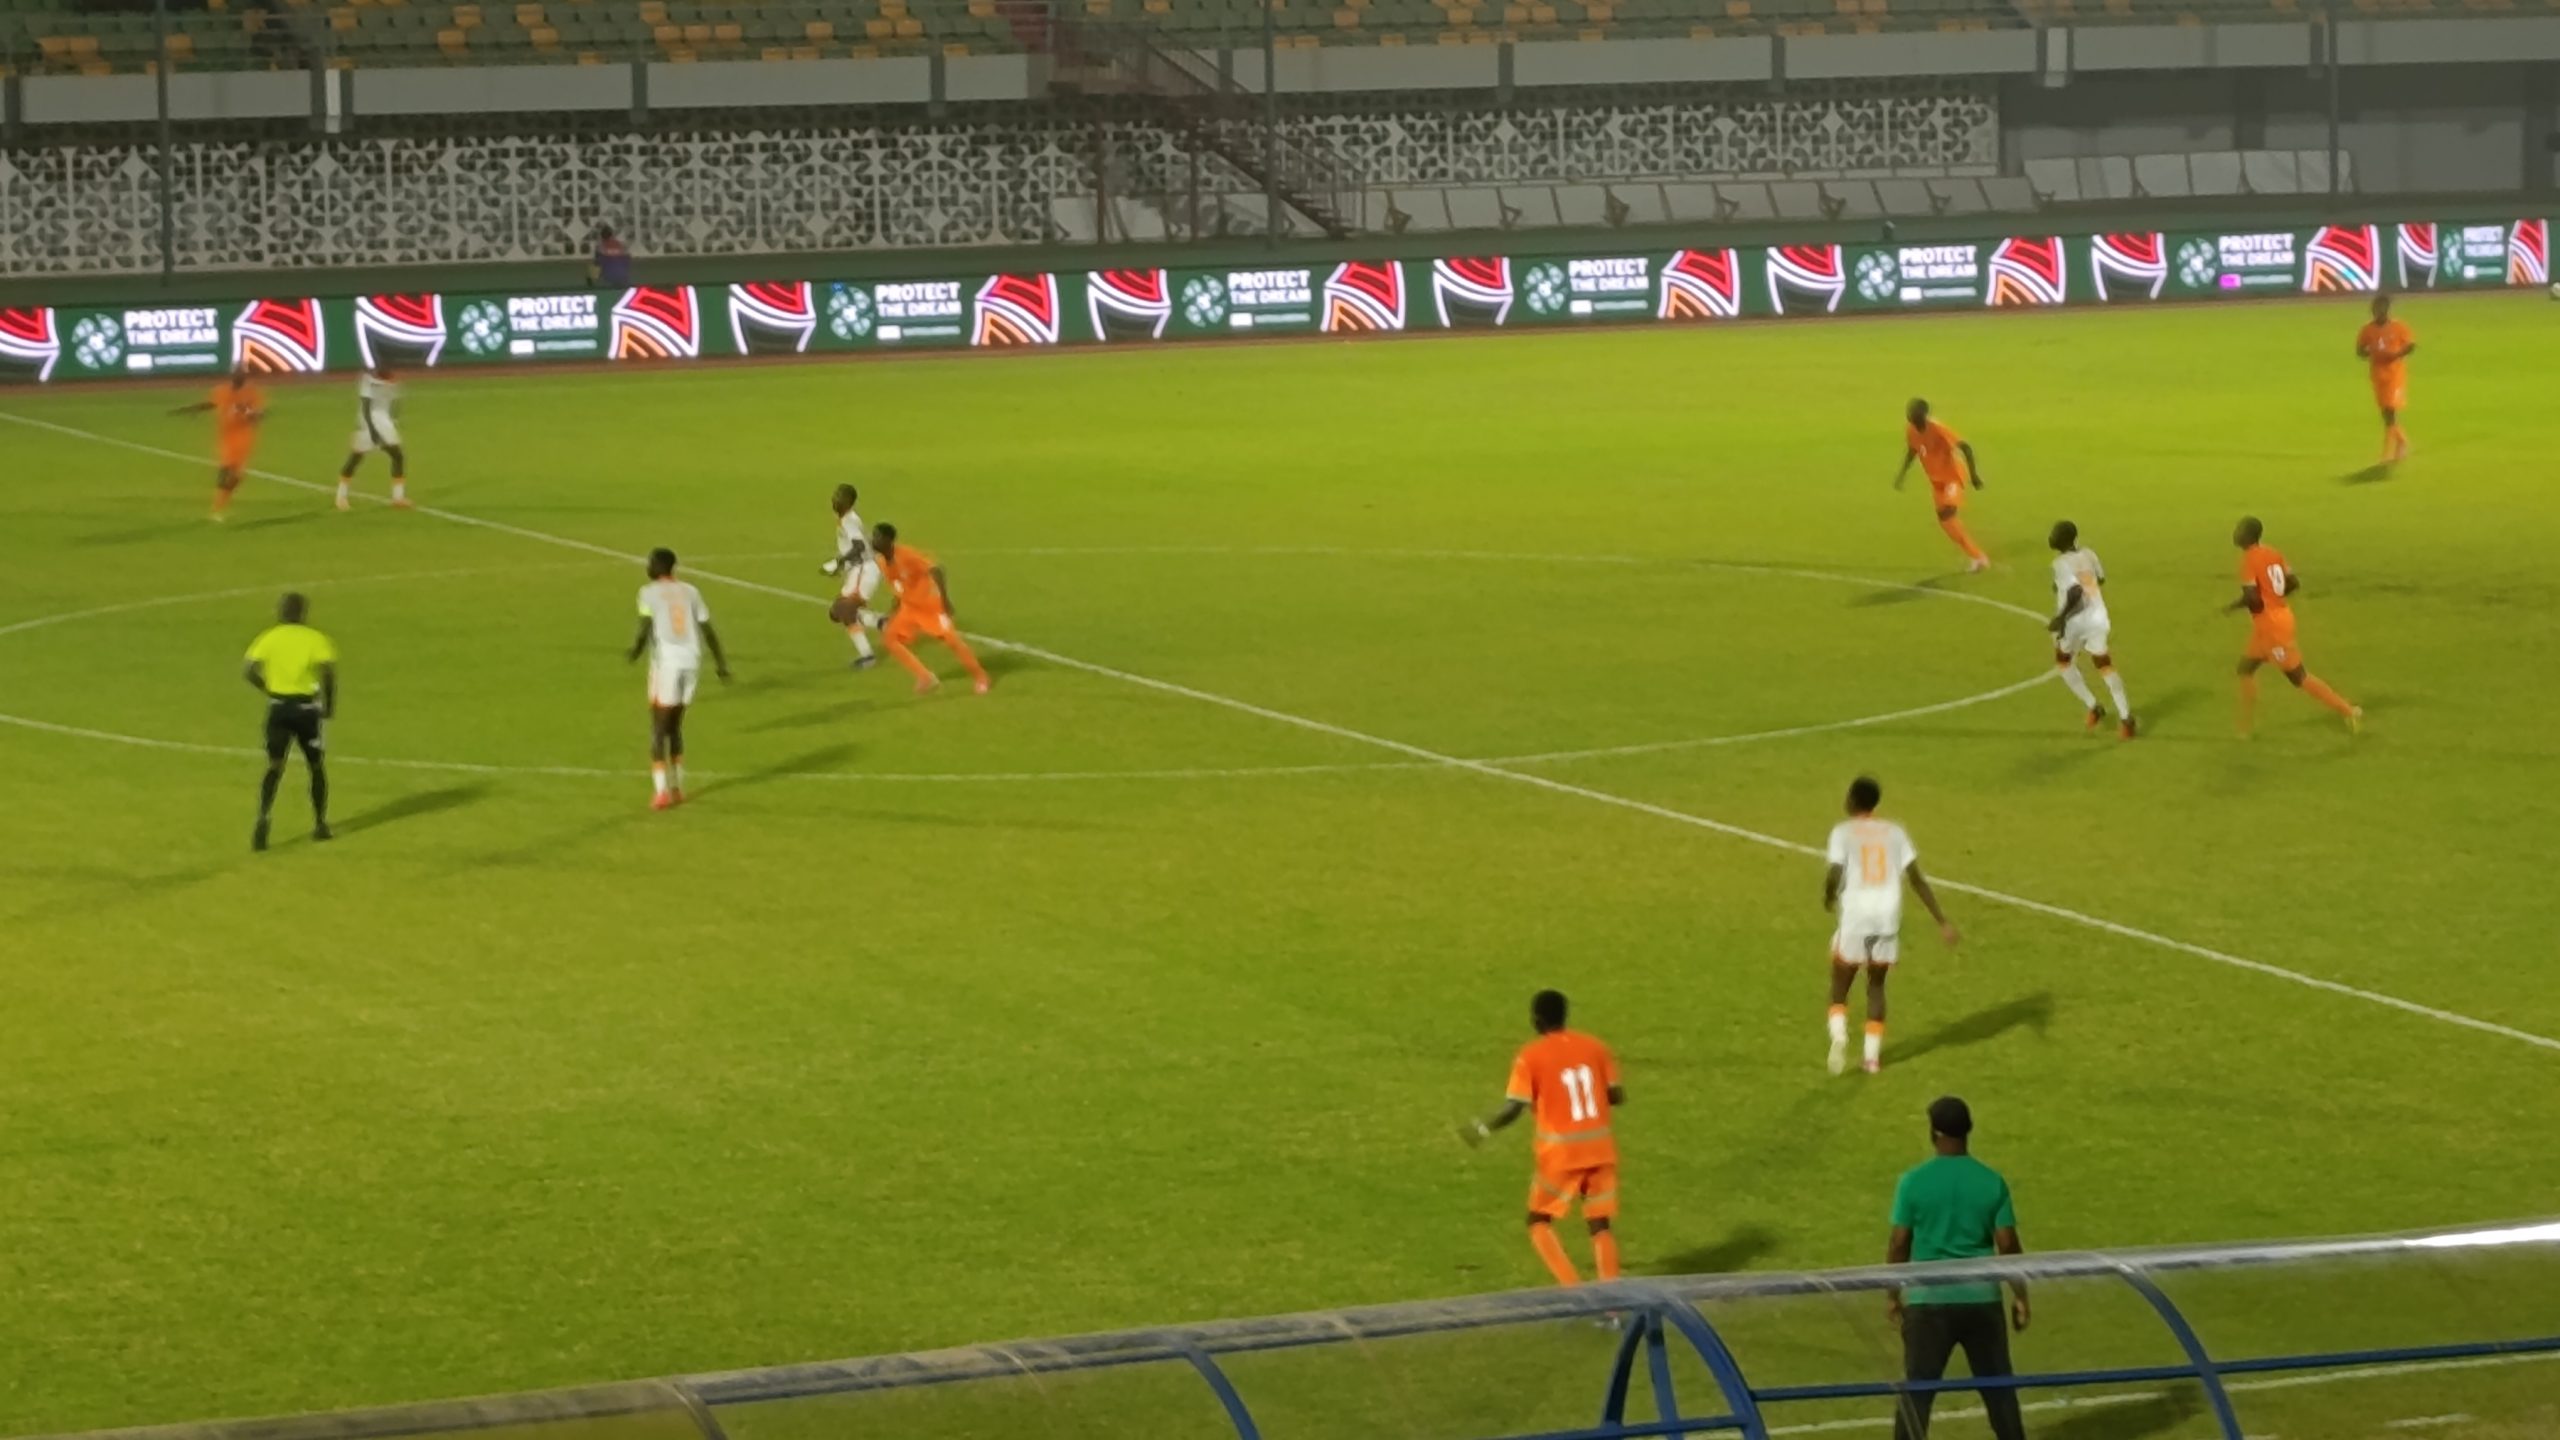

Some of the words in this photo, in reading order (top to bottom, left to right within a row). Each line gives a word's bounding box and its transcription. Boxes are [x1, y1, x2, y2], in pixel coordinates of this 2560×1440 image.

[1568, 257, 1648, 277] PROTECT
[1227, 270, 1311, 289] PROTECT
[875, 282, 961, 301] PROTECT
[507, 295, 597, 316] PROTECT
[124, 308, 219, 329] PROTECT
[1560, 1064, 1599, 1121] 11
